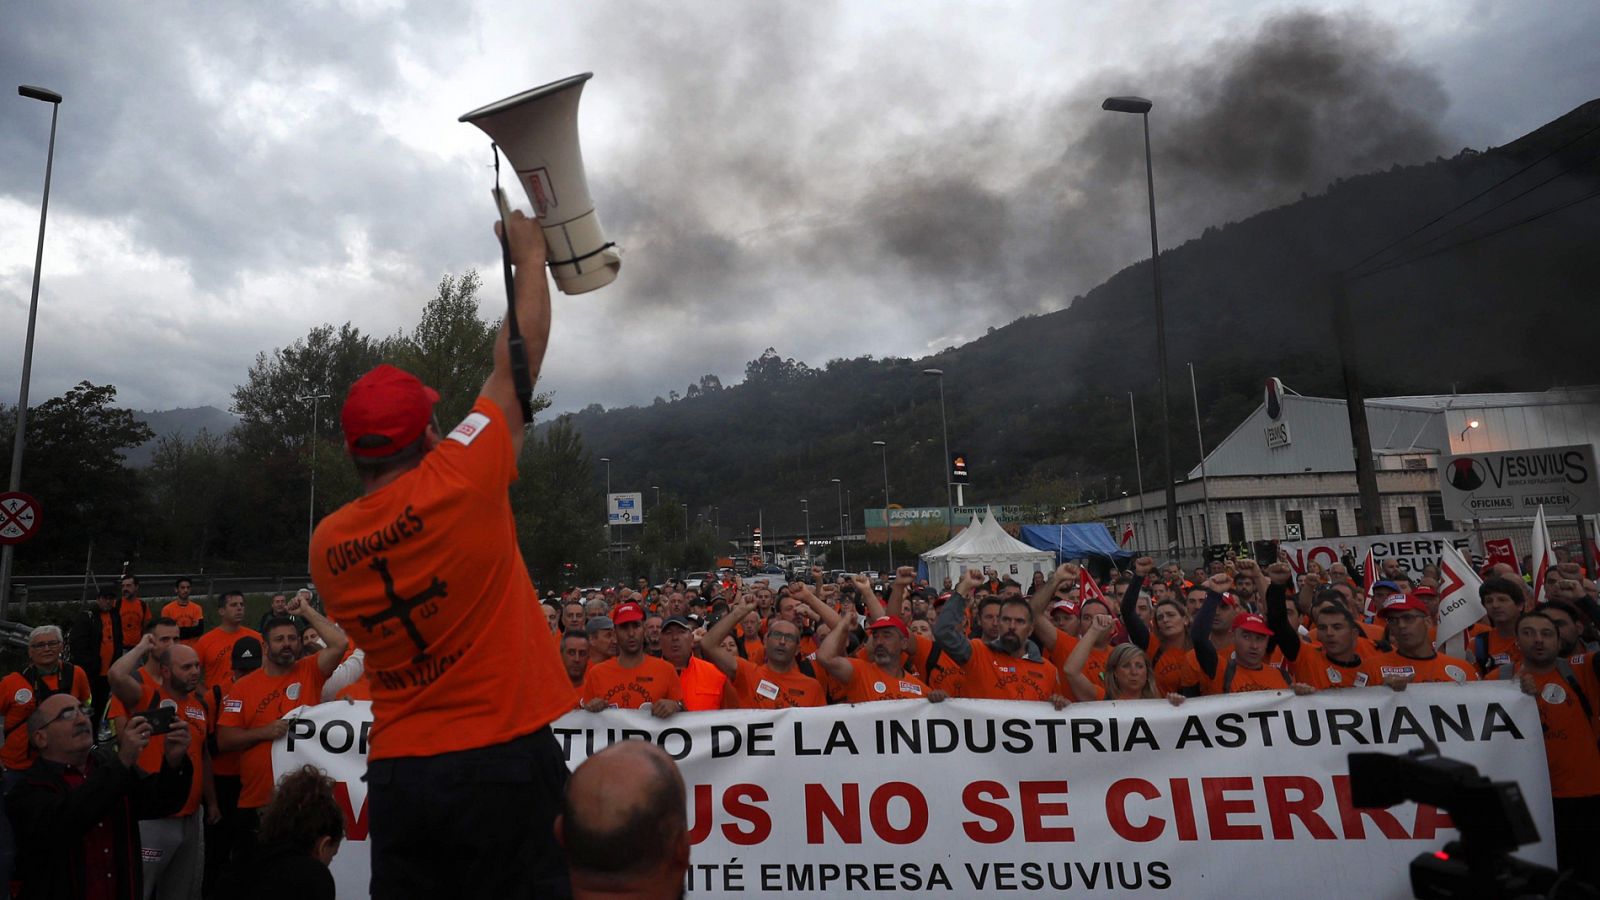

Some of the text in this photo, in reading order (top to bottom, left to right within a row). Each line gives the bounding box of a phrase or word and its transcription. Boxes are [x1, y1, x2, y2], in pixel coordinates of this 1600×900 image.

[1485, 451, 1588, 488] VESUVIUS
[1470, 498, 1512, 509] OFICINAS
[326, 504, 424, 576] CUENQUES
[1441, 597, 1466, 617] León
[711, 722, 775, 759] DE
[794, 721, 859, 756] LA
[875, 717, 1161, 754] INDUSTRIA
[1175, 702, 1525, 749] ASTURIANA
[805, 781, 929, 845] NO
[962, 780, 1075, 844] SE
[761, 862, 953, 892] EMPRESA
[964, 861, 1172, 890] VESUVIUS
